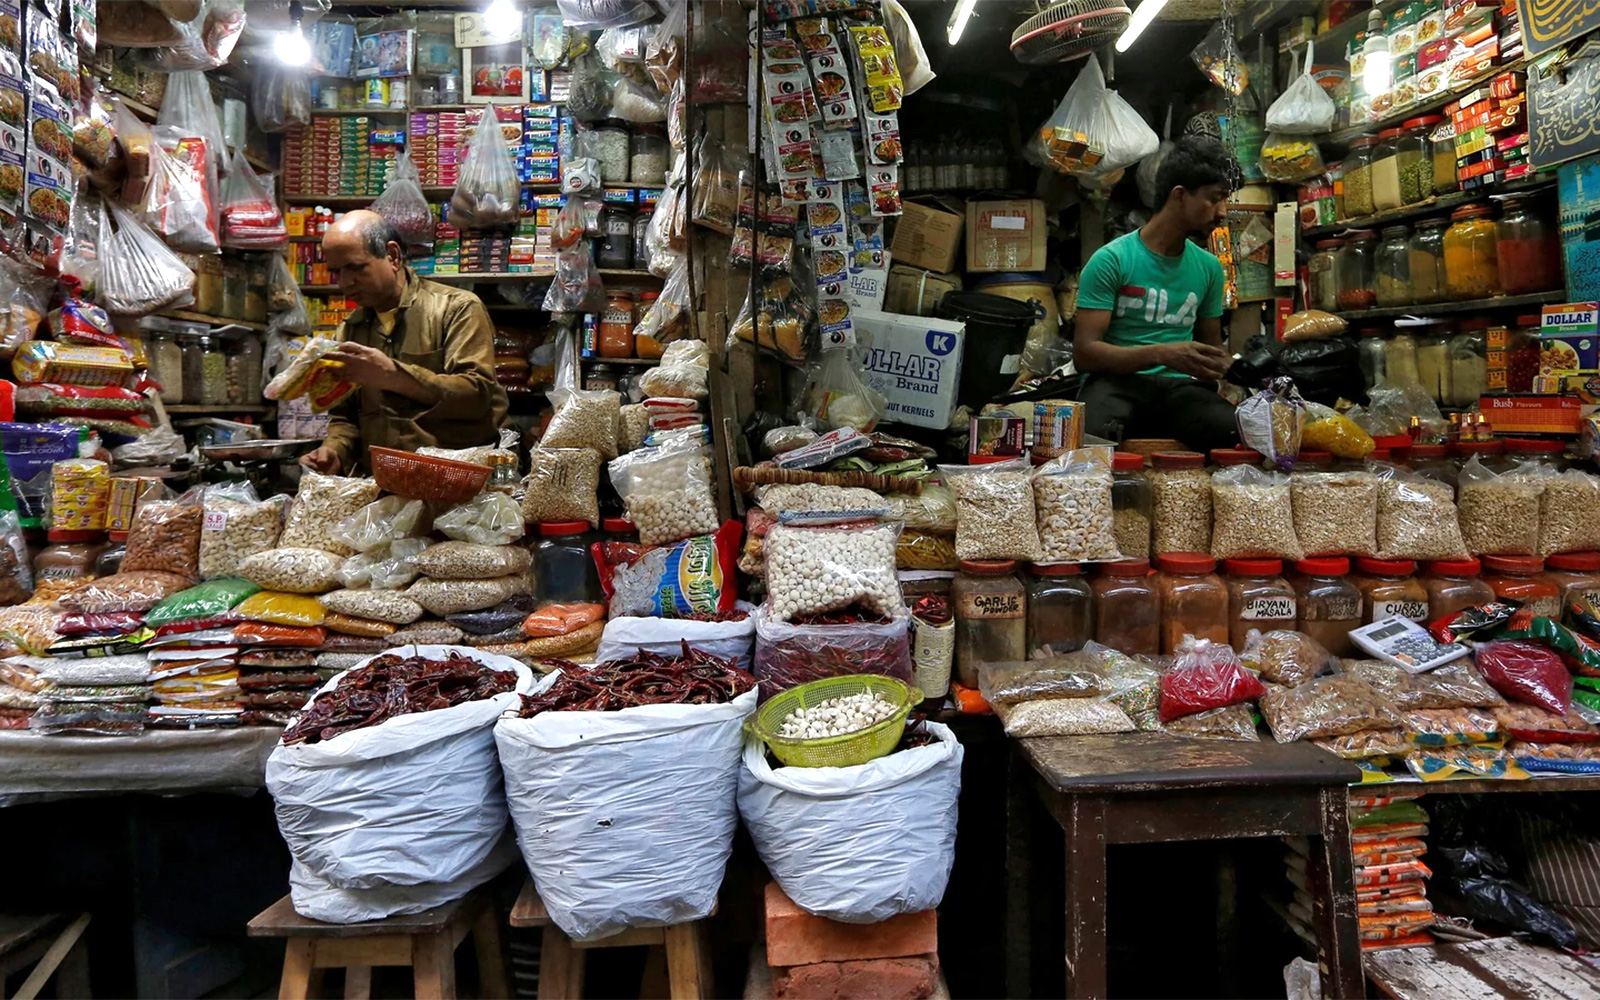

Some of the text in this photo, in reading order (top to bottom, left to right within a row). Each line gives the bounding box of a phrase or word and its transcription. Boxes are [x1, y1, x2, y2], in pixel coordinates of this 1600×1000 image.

[1117, 286, 1198, 326] FILA
[1546, 312, 1593, 326] DOLLAR
[932, 334, 949, 353] K
[896, 377, 939, 396] Brand
[1493, 398, 1514, 409] Bush
[901, 404, 935, 418] KERNELS
[974, 595, 1018, 609] GARLIC
[1247, 599, 1290, 610] BIRYANI
[1385, 602, 1423, 615] CURRY
[982, 603, 1019, 616] POWDER
[1256, 608, 1293, 618] MASALA
